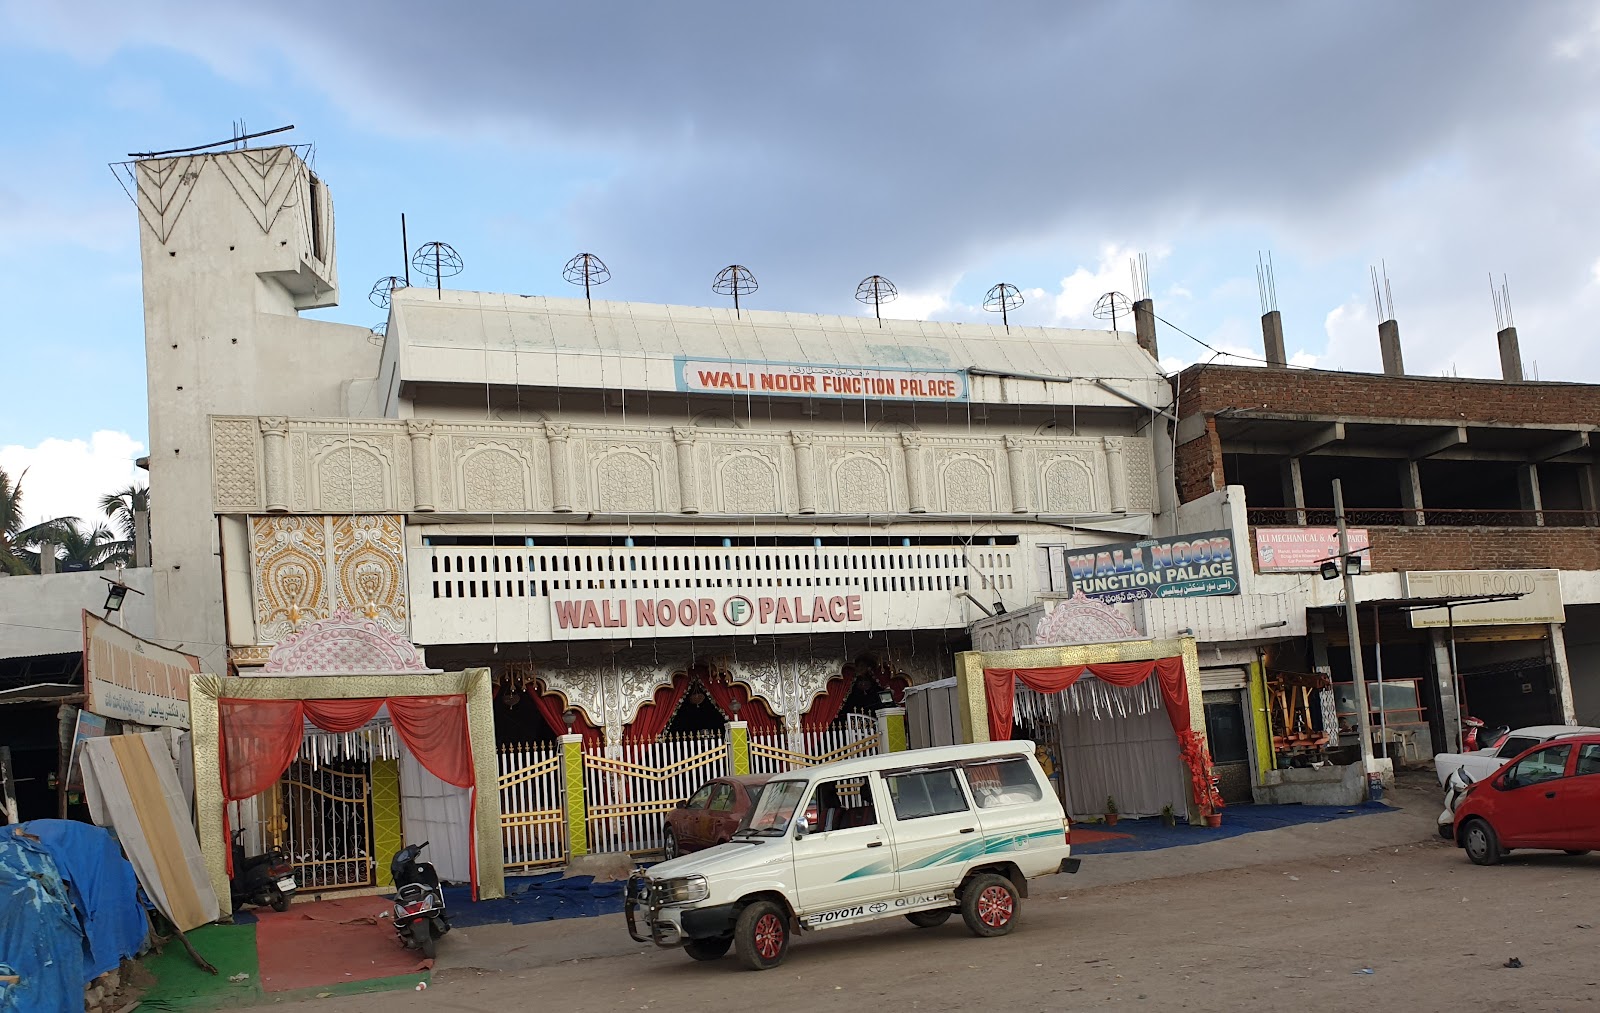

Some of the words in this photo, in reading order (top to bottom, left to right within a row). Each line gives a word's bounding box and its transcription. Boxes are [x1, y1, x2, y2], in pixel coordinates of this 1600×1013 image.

[697, 370, 755, 390] WALI
[761, 373, 817, 393] NOOR
[822, 375, 896, 395] FUNCTION
[900, 378, 956, 397] PALACE
[1258, 534, 1270, 543] ALI
[1271, 533, 1318, 543] MECHANICAL
[1319, 533, 1326, 542] &
[1347, 534, 1368, 543] PARTS
[1067, 547, 1145, 579] WALI
[1150, 536, 1233, 570] NOOR
[1071, 570, 1162, 594] FUNCTION
[1166, 561, 1234, 583] PALACE
[1434, 574, 1473, 596] UNI
[1478, 573, 1536, 595] FOOD
[554, 598, 628, 630] WALI
[635, 597, 718, 627] NOOR
[730, 600, 746, 622] F
[758, 594, 863, 624] PALACE
[818, 906, 864, 923] TOYOTA
